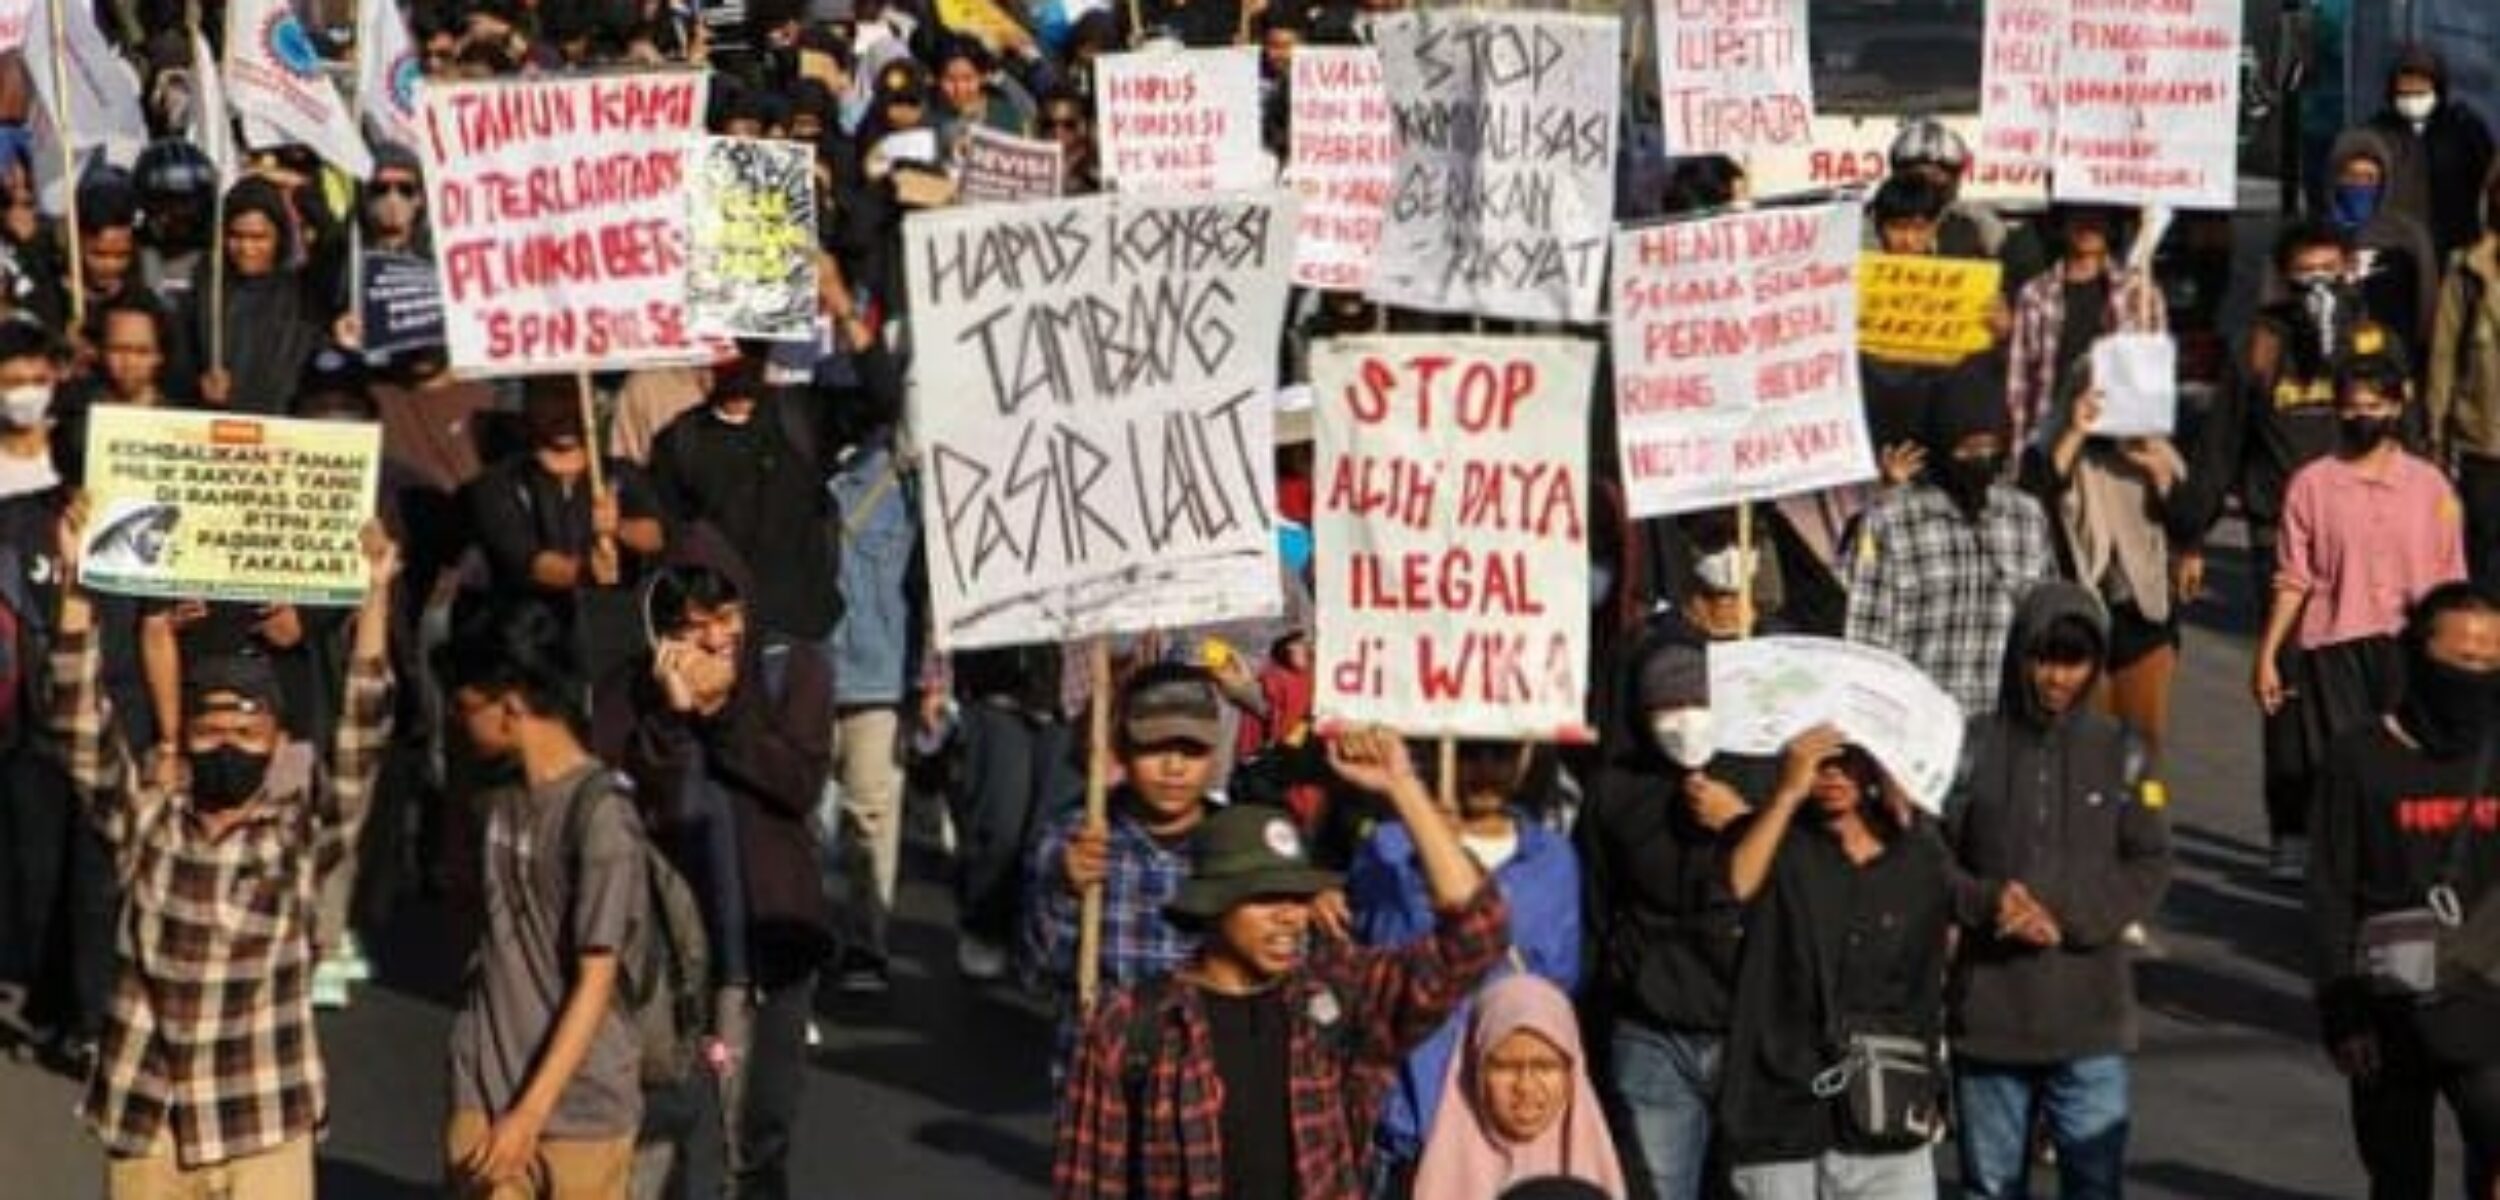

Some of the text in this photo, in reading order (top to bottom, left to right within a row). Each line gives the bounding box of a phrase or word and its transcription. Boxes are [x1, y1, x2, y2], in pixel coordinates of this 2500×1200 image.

[1414, 23, 1563, 92] STOP
[452, 86, 577, 156] TAHUN
[589, 82, 696, 134] KAMI
[927, 205, 1271, 304] HAPUS KONSESI
[1638, 214, 1819, 268] HENTIKAN
[957, 276, 1236, 415] TAMBANG
[1345, 357, 1535, 432] STOP
[108, 439, 366, 470] KEMBALIKAN TANAH
[181, 466, 286, 487] RAKYAT
[184, 488, 288, 511] RAMPAS
[242, 510, 310, 531] PTPN
[931, 388, 1270, 594] PASIR LAUT
[1458, 459, 1581, 543] DAYA
[196, 529, 283, 549] PABRIK
[228, 553, 345, 573] TAKALAR
[1350, 548, 1545, 616] ILEGAL
[1333, 630, 1577, 704] di WIKA
